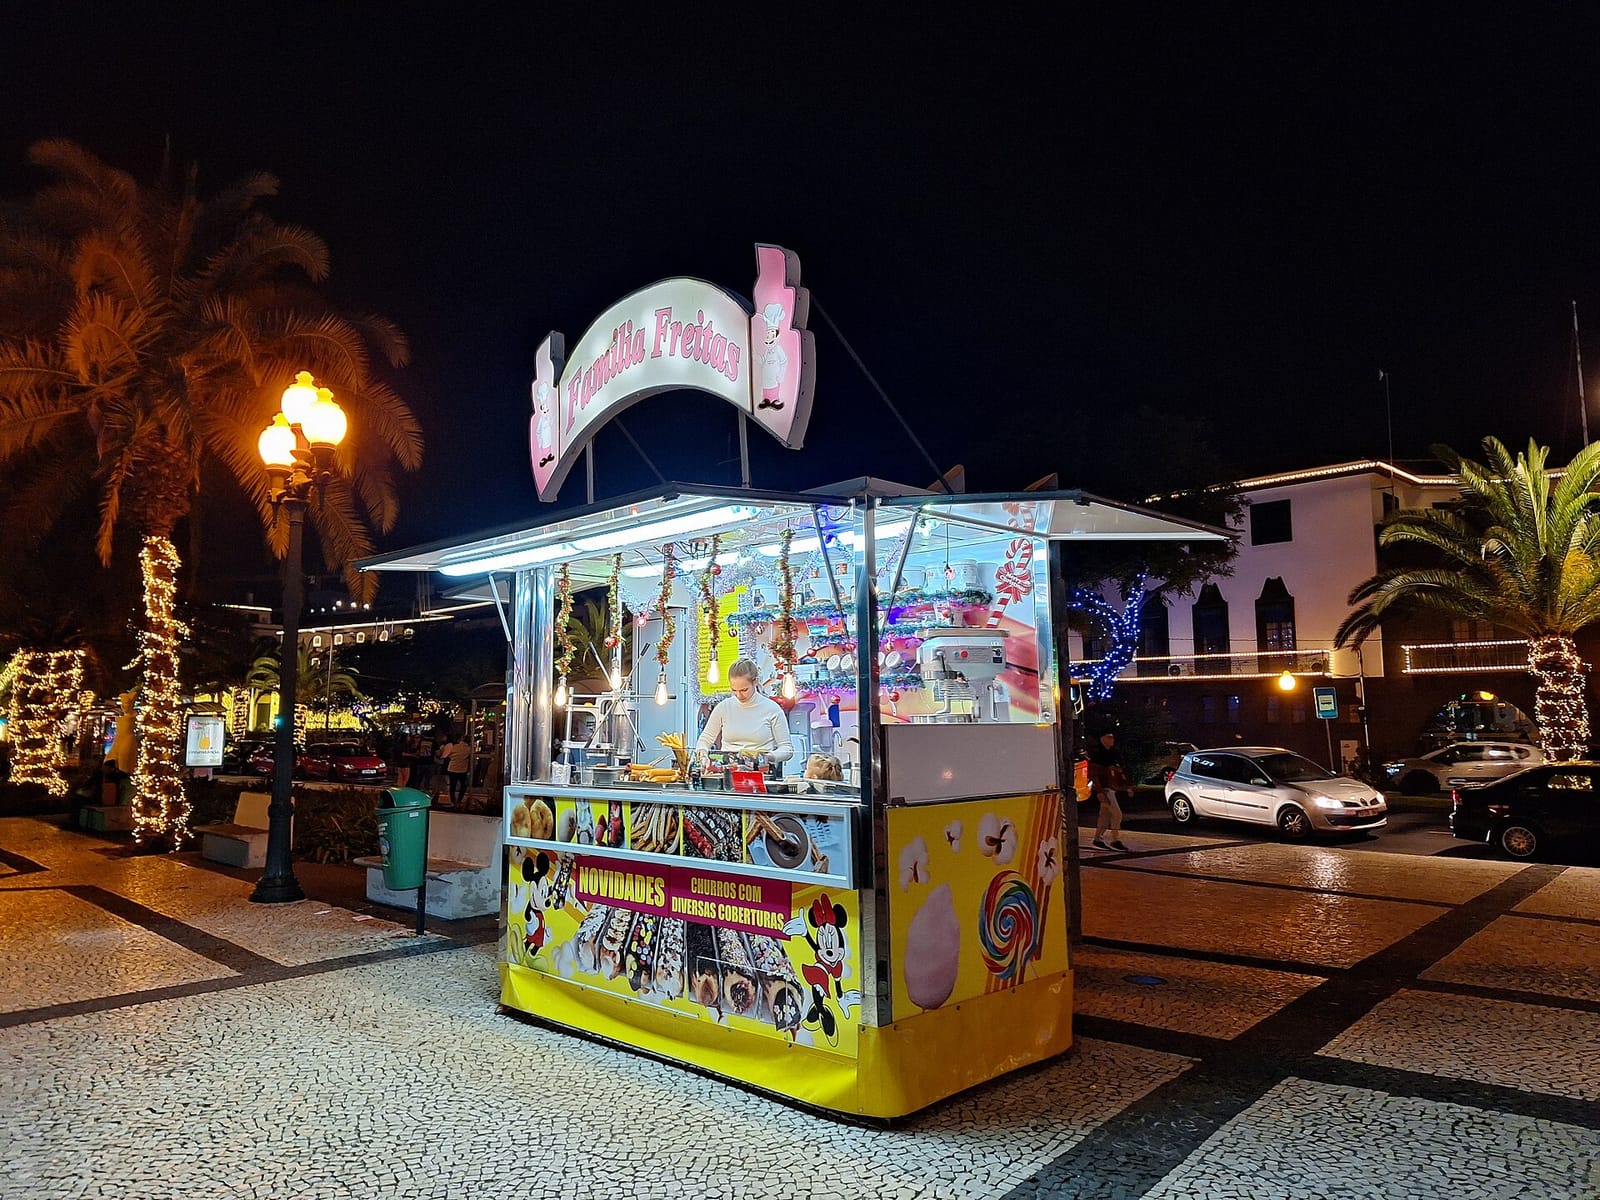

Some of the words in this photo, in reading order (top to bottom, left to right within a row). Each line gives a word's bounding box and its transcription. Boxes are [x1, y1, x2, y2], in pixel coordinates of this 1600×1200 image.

[565, 319, 646, 435] Familia
[650, 306, 741, 382] Freitas
[578, 866, 666, 908] NOVIDADES
[690, 876, 737, 900] CHURROS
[738, 883, 762, 903] COM
[671, 896, 717, 920] DIVERSAS
[718, 903, 785, 931] COBERTURAS
